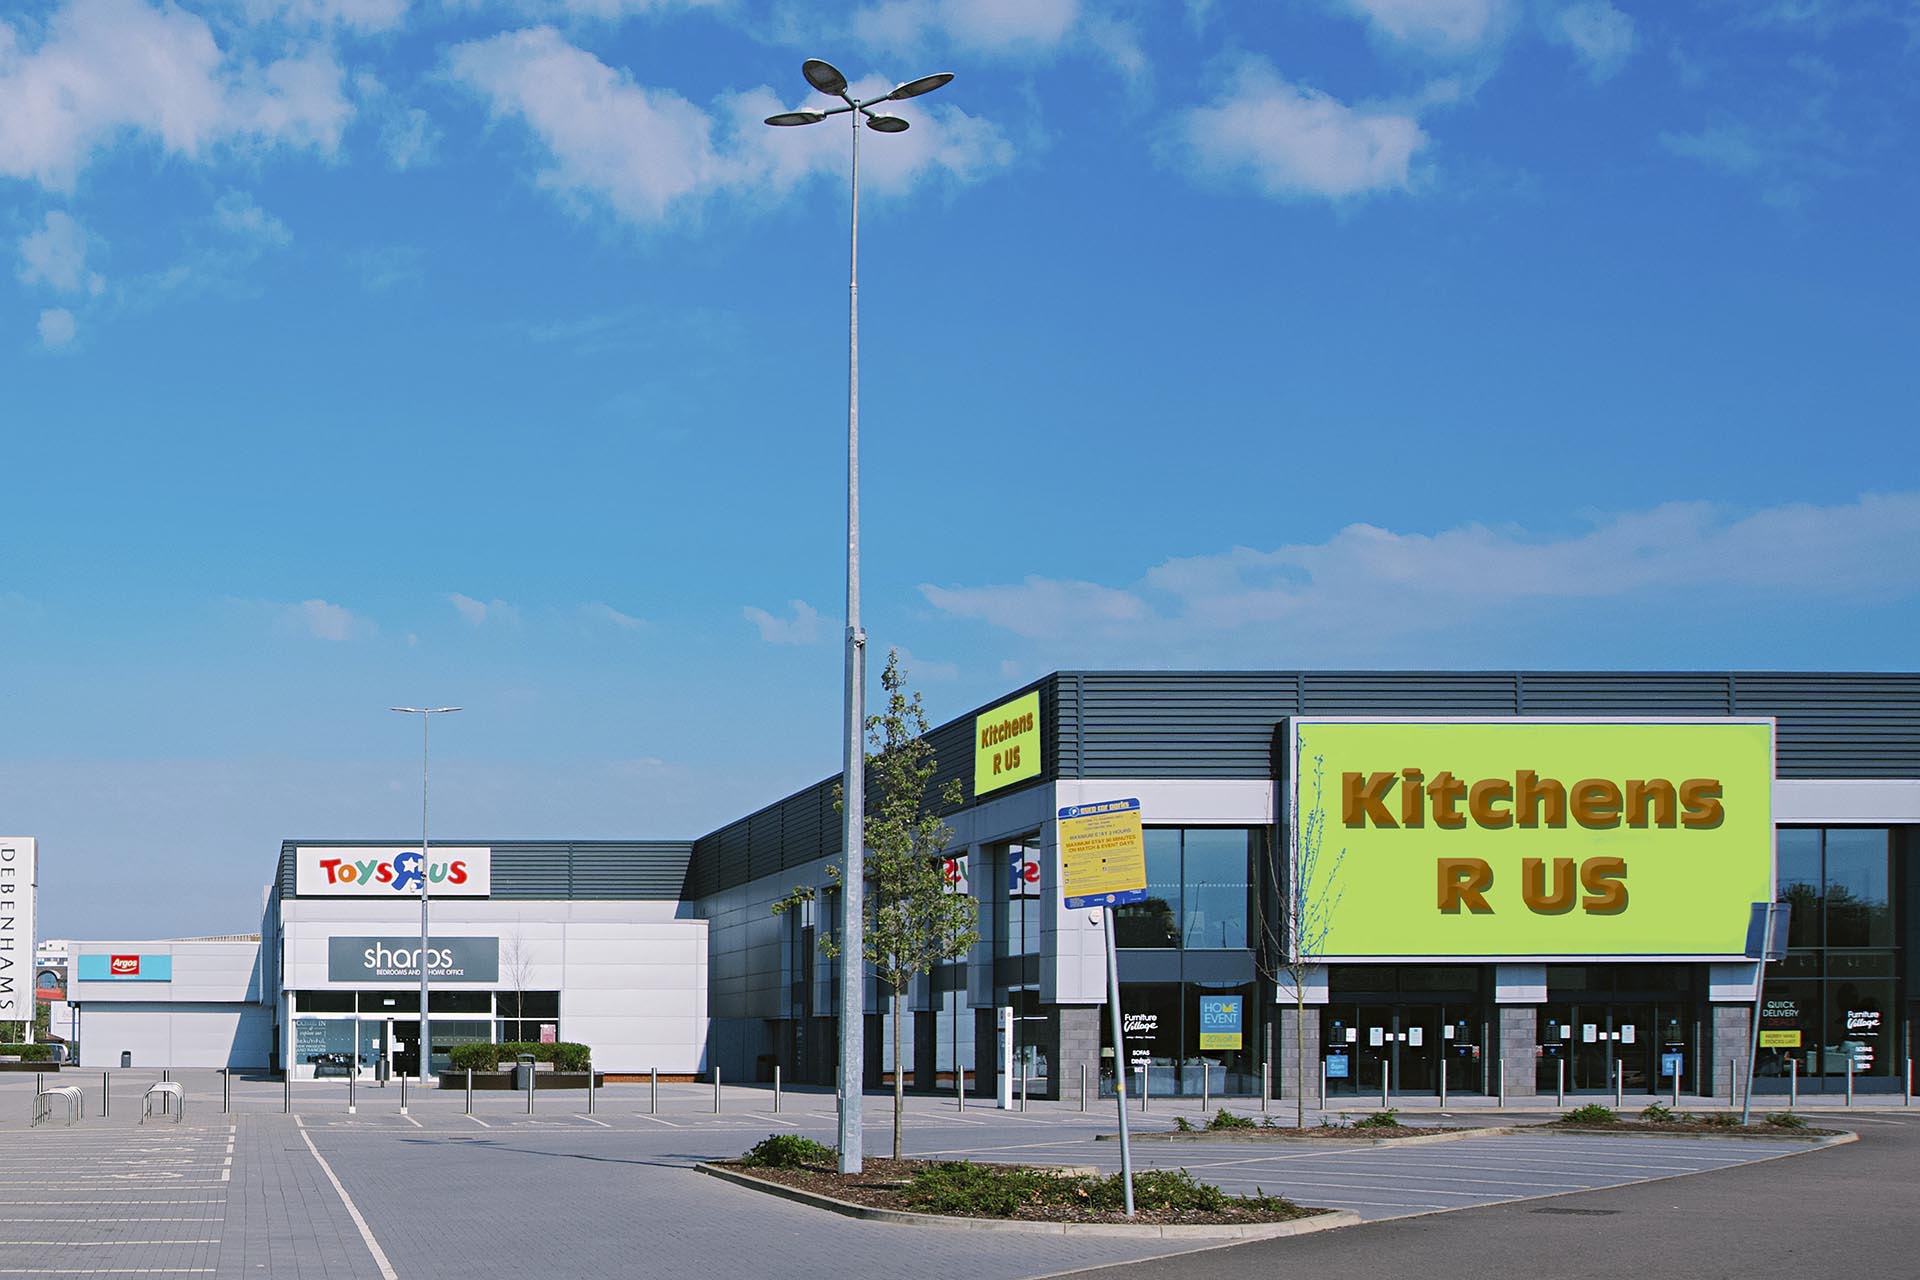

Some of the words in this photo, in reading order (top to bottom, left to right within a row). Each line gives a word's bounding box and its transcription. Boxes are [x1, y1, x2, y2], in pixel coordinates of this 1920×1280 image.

[982, 712, 1033, 749] Kitchens
[994, 753, 1002, 775] R
[1004, 745, 1020, 772] US
[1341, 768, 1724, 829] Kitchens
[1437, 858, 1495, 914] R
[1522, 857, 1629, 915] US
[0, 848, 16, 1010] DEBENHAMS
[112, 958, 138, 968] Argos
[1204, 1002, 1238, 1013] HOME
[1767, 1001, 1796, 1009] QUICK
[1204, 1013, 1238, 1024] EVENT
[1847, 1018, 1882, 1029] Village
[1124, 1020, 1158, 1032] Village
